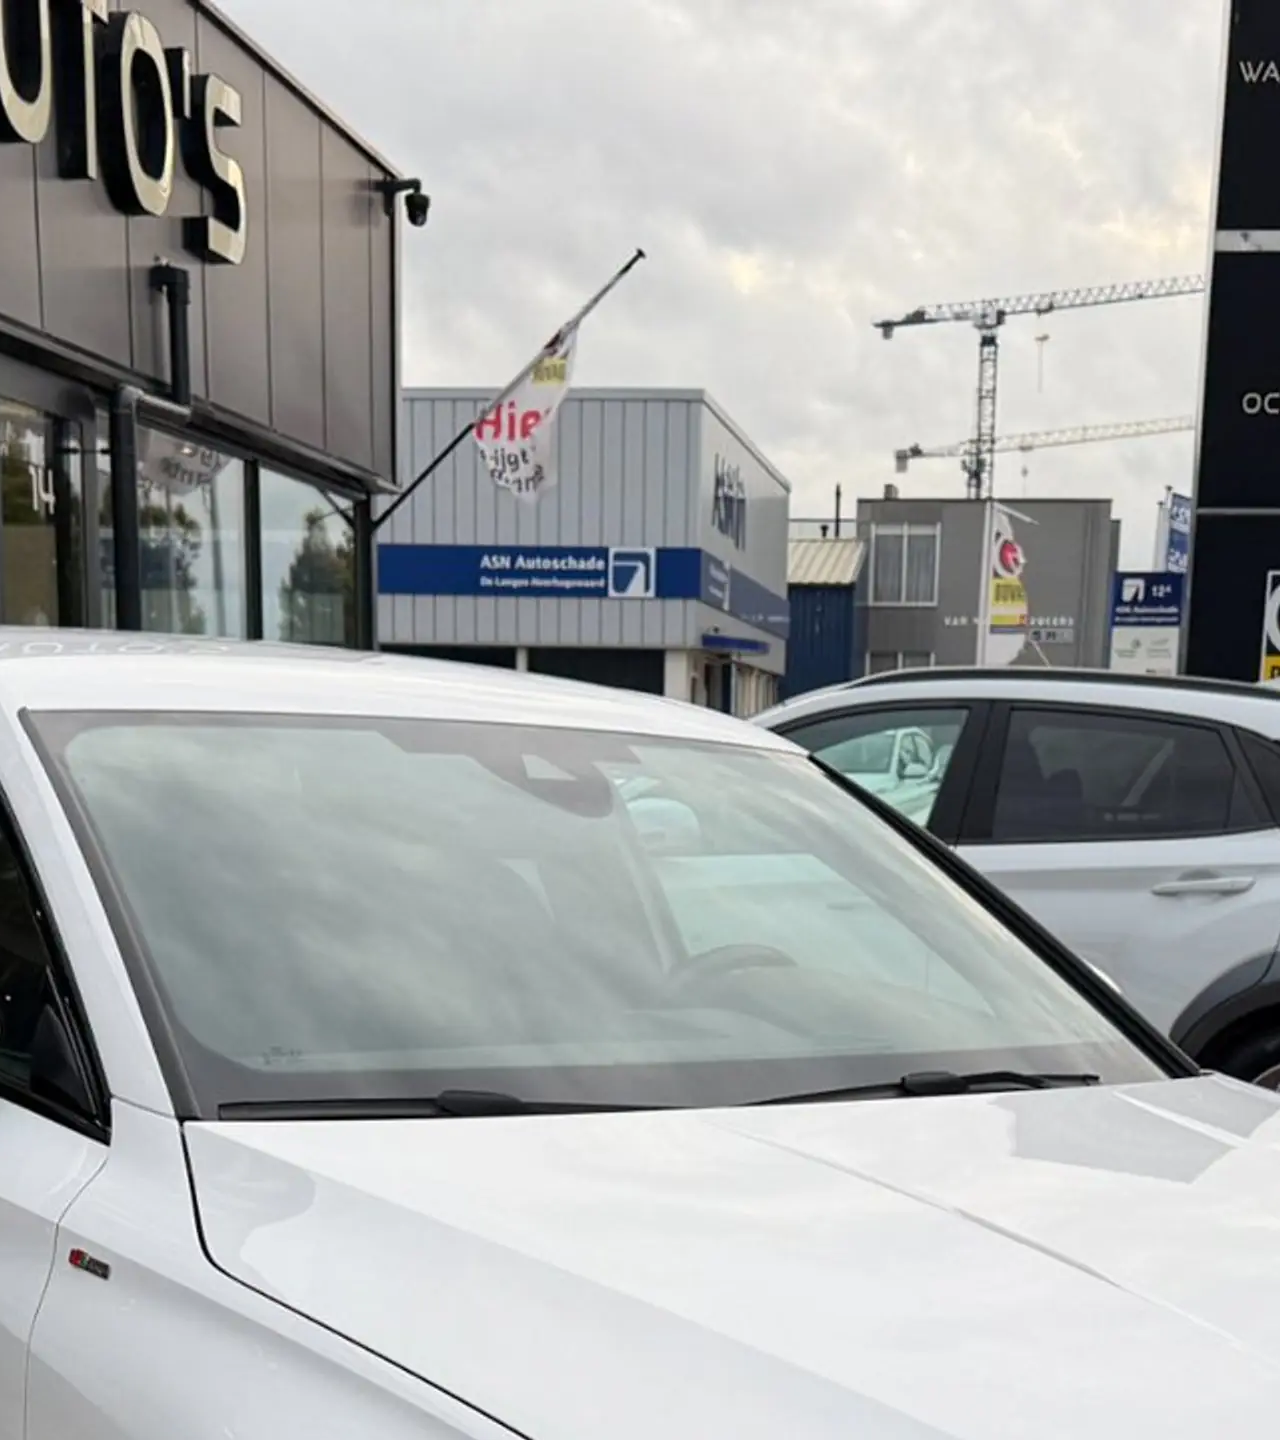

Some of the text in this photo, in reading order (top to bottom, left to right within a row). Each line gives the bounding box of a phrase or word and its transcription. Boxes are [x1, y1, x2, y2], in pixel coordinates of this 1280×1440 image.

[475, 401, 552, 441] Hie
[28, 464, 56, 515] 14
[480, 554, 606, 570] ASN Autoschade
